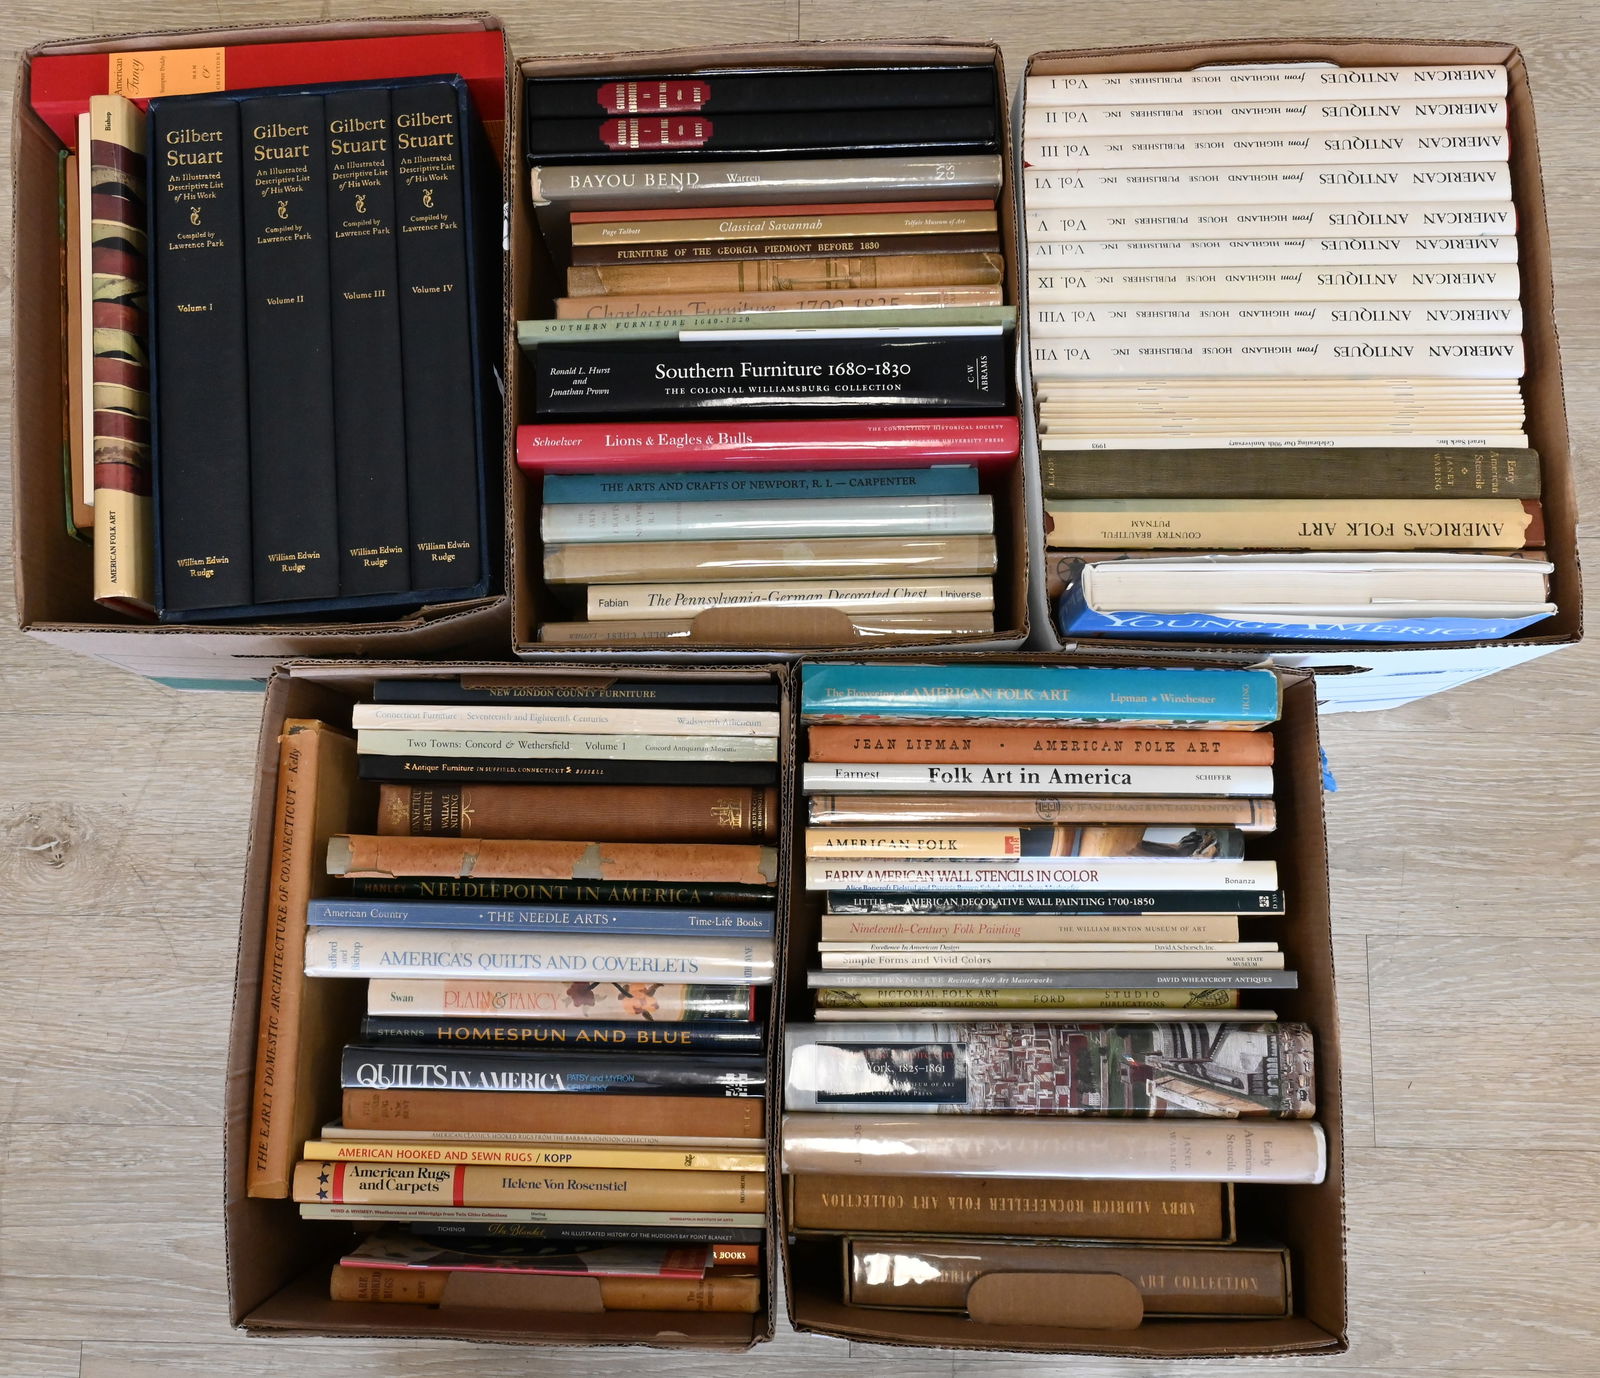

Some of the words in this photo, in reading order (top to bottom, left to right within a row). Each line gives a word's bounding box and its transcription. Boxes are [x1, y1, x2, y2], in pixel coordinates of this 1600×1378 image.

[1230, 74, 1280, 82] HIGHLAND
[1284, 72, 1306, 83] from
[1321, 71, 1399, 84] ANTIQUES
[1414, 69, 1497, 82] AMERICAN
[1064, 79, 1088, 89] Vol.
[330, 118, 386, 133] Gilbert
[397, 113, 453, 127] Gilbert
[166, 129, 223, 145] Gilbert
[254, 124, 309, 140] Gilbert
[331, 138, 387, 155] Stuart
[398, 133, 454, 149] Stuart
[1234, 140, 1284, 148] HIGHLAND
[1288, 138, 1310, 149] from
[1324, 136, 1404, 150] ANTIQUES
[1418, 136, 1502, 148] AMERICAN
[254, 144, 309, 161] Stuart
[1042, 146, 1059, 157] III
[1064, 145, 1090, 157] Vol.
[167, 150, 223, 167] Stuart
[414, 154, 452, 164] Illustrated
[400, 165, 439, 175] Descriptive
[416, 175, 428, 183] His
[570, 174, 635, 189] BAYOU
[644, 172, 700, 187] BEND
[726, 174, 761, 184] Warren
[720, 221, 764, 232] Classical
[768, 220, 823, 231] Savannah
[618, 248, 668, 259] FURNITURE
[674, 248, 687, 257] OF
[693, 248, 712, 256] THE
[718, 246, 758, 255] GEORGIA
[764, 244, 812, 253] PIEDMONT
[818, 242, 854, 251] BEFORE
[860, 242, 880, 250] 1830
[412, 286, 440, 294] Volume
[443, 284, 453, 293] IV
[550, 366, 577, 375] Ronald
[579, 366, 586, 375] L.
[588, 366, 611, 374] Hurst
[656, 364, 735, 380] Southern
[740, 361, 822, 378] Furniture
[828, 362, 911, 378] 1680-1830
[981, 355, 989, 392] ABRAMS
[550, 387, 584, 398] Jonathan
[586, 388, 609, 396] Prown
[690, 386, 744, 395] COLONIAL
[749, 385, 830, 393] WILLIAMSBURG
[835, 384, 901, 392] COLLECTION
[532, 437, 583, 447] Schoelwer
[606, 434, 642, 447] Lions
[646, 436, 654, 446] &
[658, 433, 702, 449] Eagles
[706, 435, 714, 445] &
[718, 432, 753, 445] Bulls
[601, 482, 623, 492] THE
[628, 482, 655, 491] ARTS
[658, 482, 683, 491] AND
[686, 482, 729, 491] CRAFTS
[732, 481, 747, 490] OF
[750, 480, 809, 490] NEWPORT,
[812, 479, 824, 488] R.
[849, 477, 916, 488] CARPENTER
[1131, 520, 1171, 528] PUTNAM
[1298, 522, 1337, 536] ART
[1346, 522, 1394, 537] FOLK
[1404, 522, 1504, 537] AMERICA'S
[1101, 531, 1152, 539] BEAUTIFUL
[1156, 532, 1201, 540] COUNTRY
[599, 598, 629, 607] Fabian
[513, 689, 554, 697] LONDON
[557, 690, 595, 698] COUNTY
[600, 690, 657, 698] FURNITURE
[407, 739, 427, 748] Two
[430, 739, 462, 749] Towns:
[465, 740, 502, 749] Concord
[506, 740, 515, 749] &
[518, 740, 570, 750] Wethersfield
[585, 742, 619, 751] Volume
[854, 739, 896, 750] JEAN
[907, 740, 971, 750] LIPMAN
[1034, 740, 1123, 752] AMERICAN
[1134, 741, 1176, 752] FOLK
[1187, 742, 1221, 753] ART
[288, 748, 301, 774] Kelly
[928, 767, 972, 784] Folk
[981, 768, 1012, 784] Art
[1020, 768, 1040, 784] in
[1048, 768, 1132, 785] America
[280, 788, 297, 883] CONNECTICUT
[1224, 877, 1256, 885] Bonanza
[278, 884, 289, 902] OF
[420, 882, 568, 900] NEEDLEPOINT
[578, 886, 600, 900] IN
[608, 887, 701, 904] AMERICA
[854, 898, 884, 906] LITTLE
[904, 898, 958, 906] AMERICAN
[962, 898, 1024, 906] DECORATIVE
[1027, 898, 1053, 906] WALL
[1056, 898, 1105, 907] PAINTING
[1108, 898, 1155, 906] 1700-1850
[488, 912, 514, 923] THE
[519, 912, 570, 924] NEEDLE
[573, 914, 609, 925] ARTS
[688, 916, 733, 927] Time-Life
[736, 918, 763, 928] Books
[850, 922, 950, 937] Nineteenth-Century
[954, 923, 974, 935] Folk
[979, 924, 1021, 937] Painting
[271, 906, 288, 1013] ARCHITECTURE
[380, 952, 473, 968] AMERICA'S
[478, 954, 542, 971] QUILTS
[546, 956, 586, 970] AND
[592, 956, 699, 974] COVERLETS
[390, 992, 414, 1003] Swan
[378, 1028, 425, 1037] STEARNS
[438, 1027, 566, 1042] HOMESPUN
[576, 1030, 626, 1043] AND
[638, 1030, 692, 1044] BLUE
[264, 1018, 279, 1087] DOMESTIC
[356, 1064, 448, 1090] QUILTS
[452, 1071, 472, 1088] IN
[474, 1072, 566, 1090] AMERICA
[262, 1094, 273, 1133] EARLY
[256, 1134, 268, 1171] THE
[338, 1148, 393, 1158] AMERICAN
[396, 1150, 441, 1160] HOOKED
[444, 1150, 468, 1161] AND
[472, 1151, 501, 1161] SEWN
[505, 1152, 533, 1162] RUGS
[544, 1154, 573, 1163] KOPP
[350, 1166, 415, 1179] American
[418, 1168, 450, 1181] Rugs
[359, 1180, 385, 1191] and
[386, 1180, 440, 1194] Carpets
[822, 1194, 904, 1208] COLLECTION
[912, 1196, 938, 1210] ART
[949, 1196, 981, 1210] FOLK
[990, 1198, 1084, 1213] ROCKEFELLER
[1094, 1201, 1150, 1214] ALDRICH
[1161, 1202, 1196, 1216] ABBY
